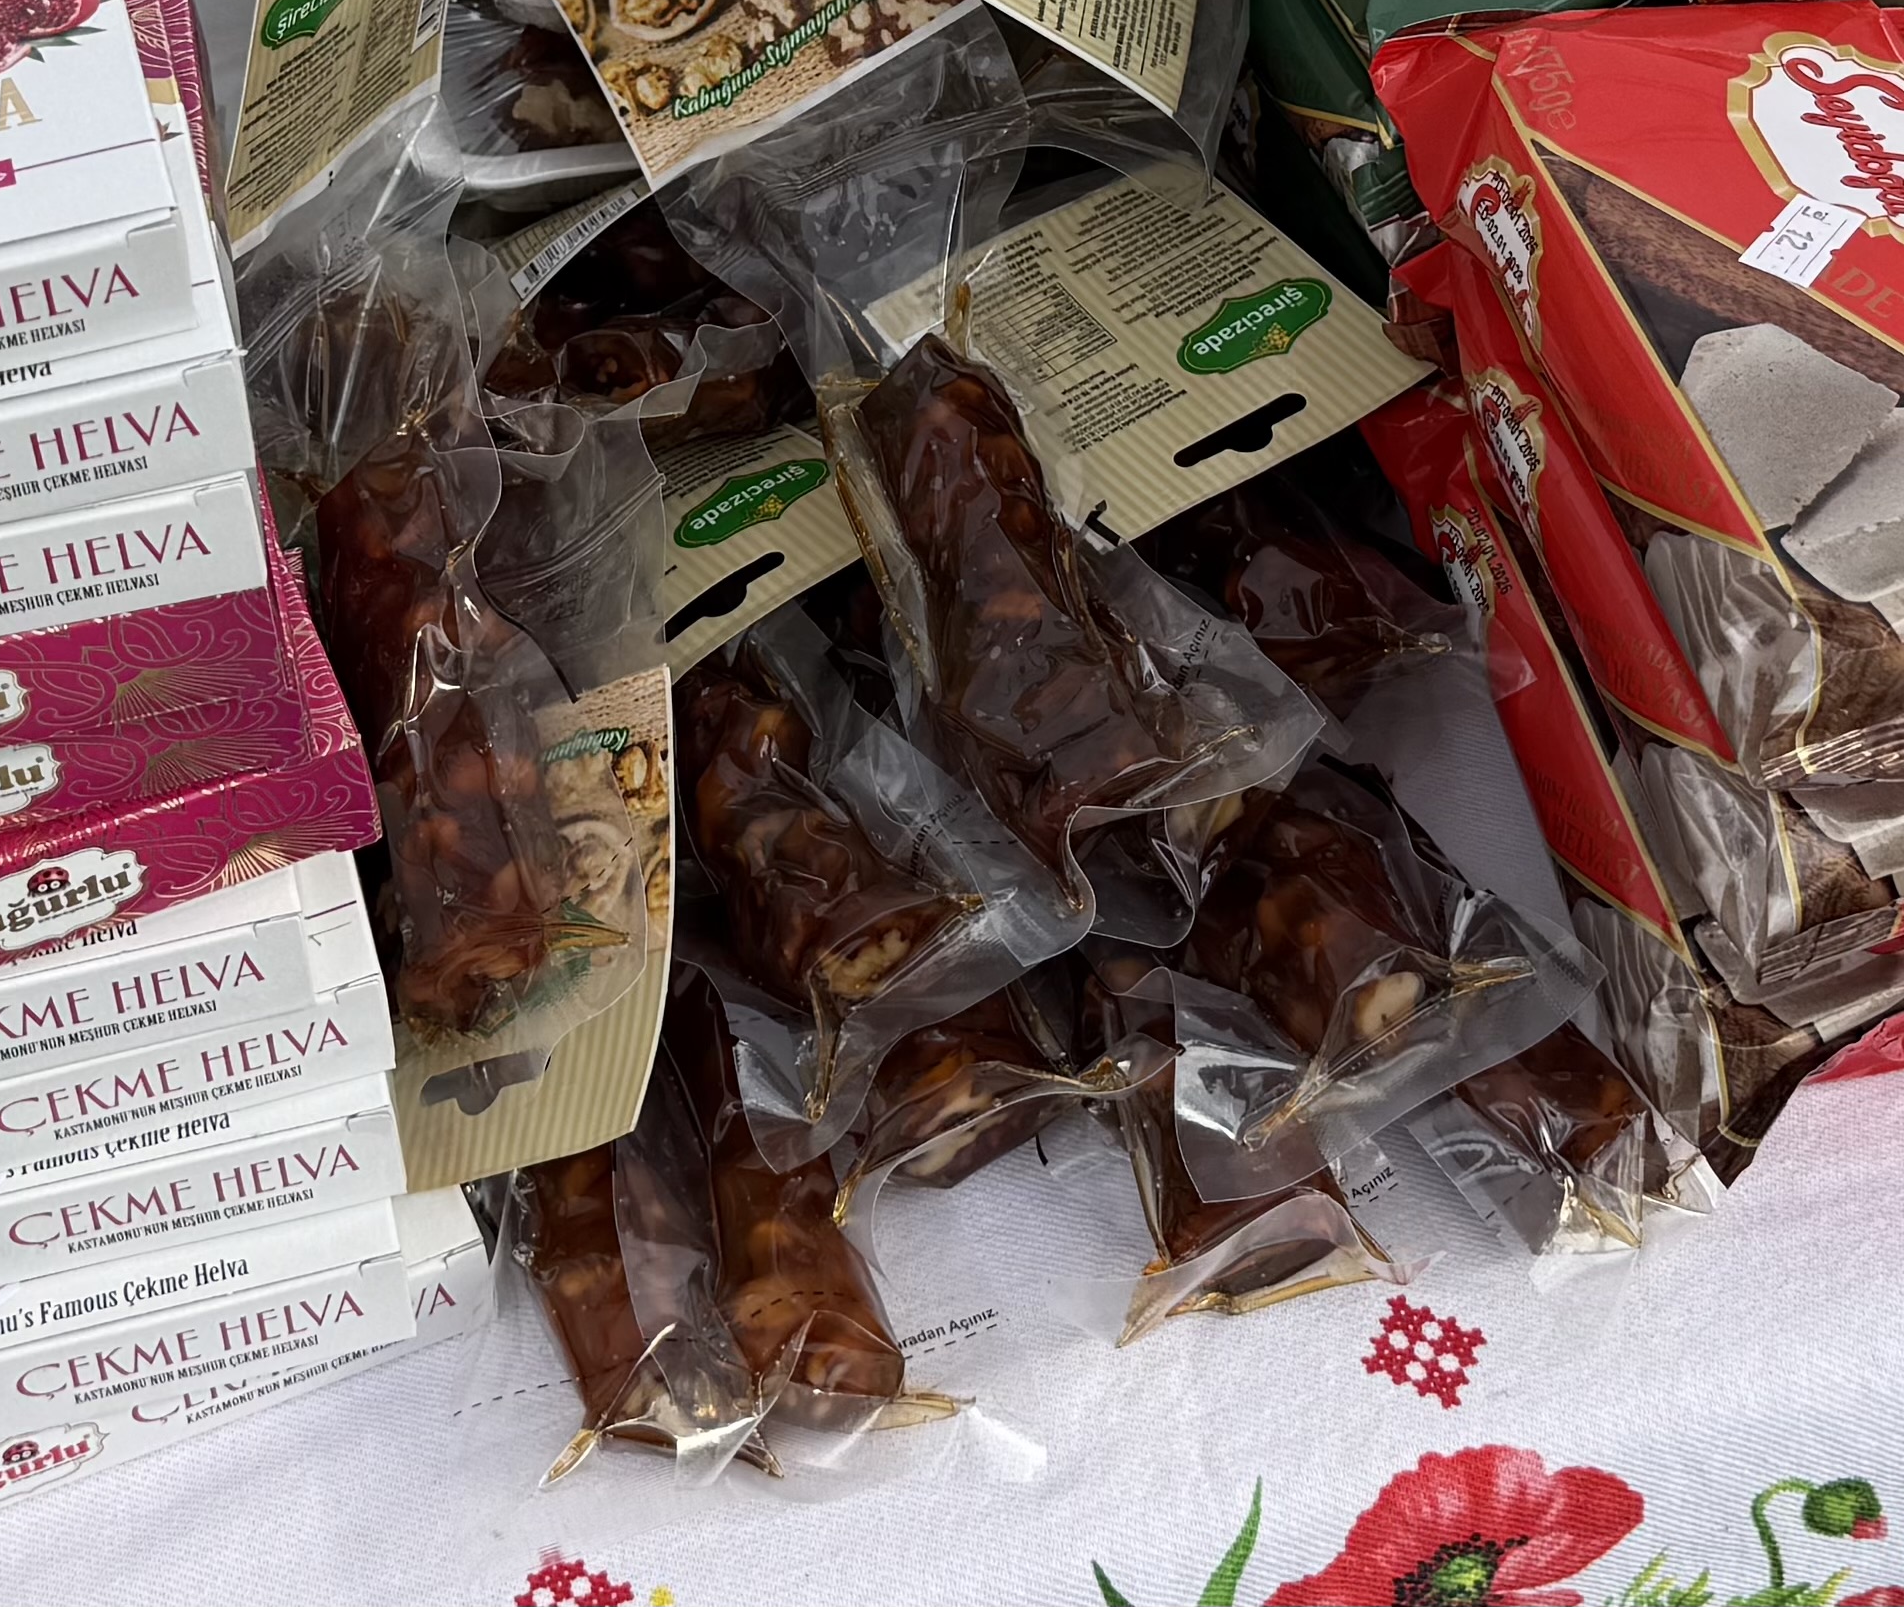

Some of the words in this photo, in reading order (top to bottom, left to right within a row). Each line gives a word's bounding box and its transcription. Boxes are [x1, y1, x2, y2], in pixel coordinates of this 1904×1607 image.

[673, 56, 764, 120] Kabuğuna
[29, 318, 87, 345] HELVASI
[1192, 281, 1307, 359] şirecizade
[29, 399, 201, 458] HELVA
[43, 468, 93, 499] ÇEKME
[94, 455, 150, 482] HELVASI
[44, 520, 212, 585] HELVA
[112, 950, 266, 1013] HELVA
[40, 1289, 119, 1326] Famous
[124, 1272, 191, 1307] Çekme
[194, 1254, 250, 1291] Helva
